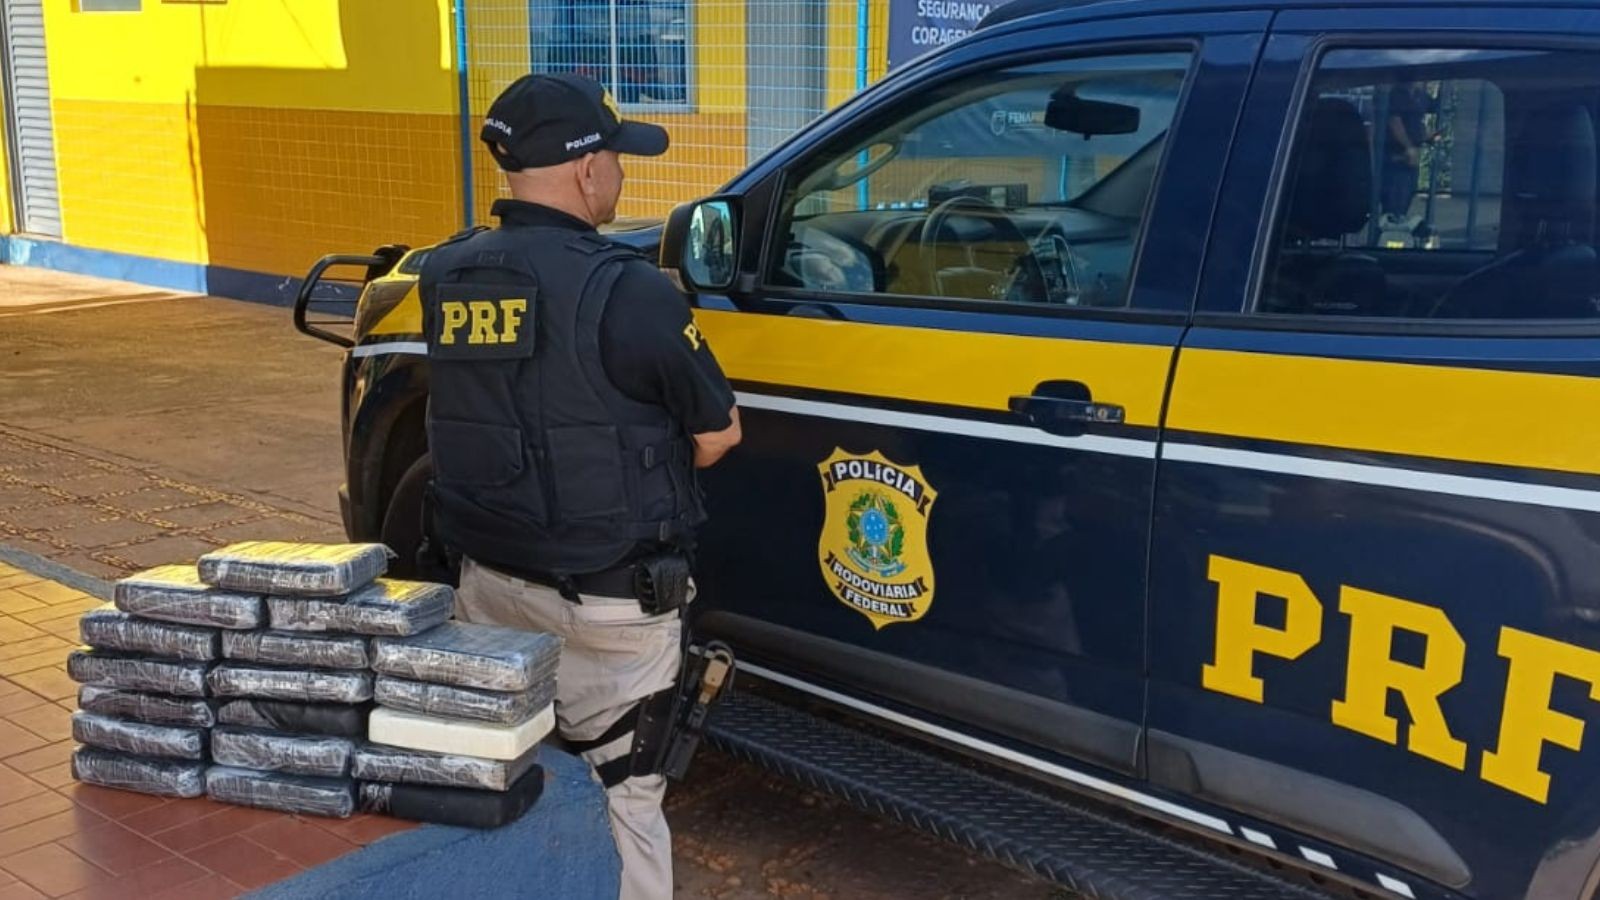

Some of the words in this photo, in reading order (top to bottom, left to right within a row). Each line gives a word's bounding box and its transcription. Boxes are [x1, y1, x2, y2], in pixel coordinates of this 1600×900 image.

[440, 299, 527, 345] PRF
[683, 323, 704, 351] P
[845, 589, 907, 617] FEDERAL
[1202, 554, 1600, 804] PRF
